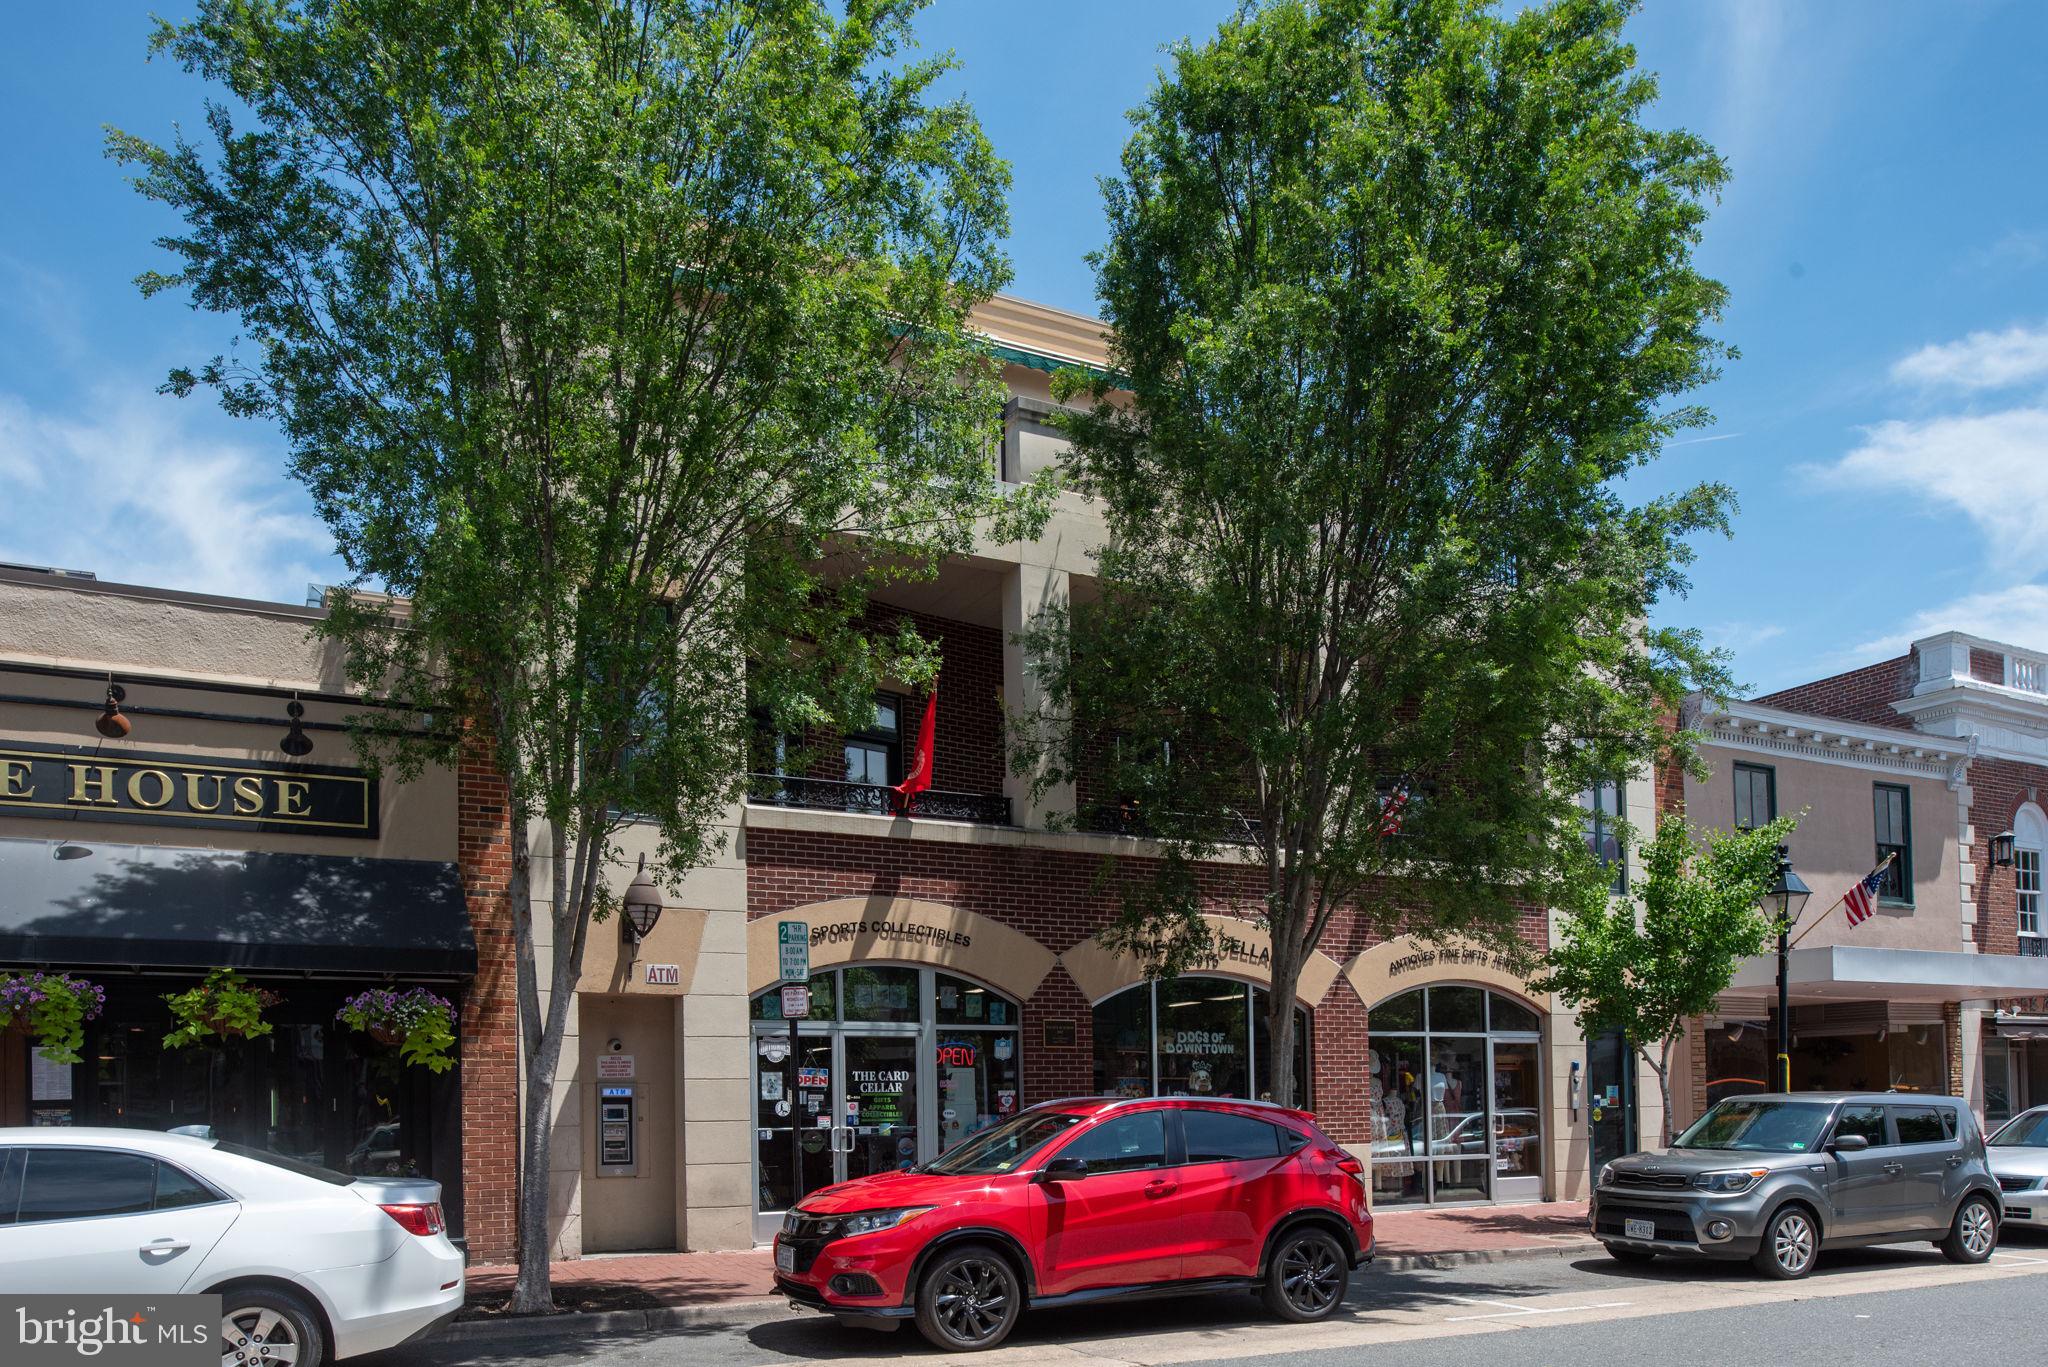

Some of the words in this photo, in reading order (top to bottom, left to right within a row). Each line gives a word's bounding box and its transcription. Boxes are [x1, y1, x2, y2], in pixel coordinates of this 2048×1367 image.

[67, 764, 313, 817] HOUSE
[780, 925, 787, 941] 2
[811, 921, 867, 940] SPORTS
[871, 921, 971, 947] COLLECTIBLES
[1168, 935, 1214, 953] CAD
[1219, 937, 1270, 962] CELLA
[1390, 950, 1435, 972] ANTIQUES
[1439, 948, 1460, 958] FINE
[1462, 949, 1488, 960] GIFTS
[648, 967, 678, 982] ATM
[1177, 1030, 1209, 1043] DOGS
[1211, 1032, 1226, 1043] OF
[1165, 1042, 1235, 1054] DOWNTOWN
[852, 1070, 876, 1081] THE
[878, 1070, 910, 1081] CARD
[860, 1082, 904, 1093] CELLAR
